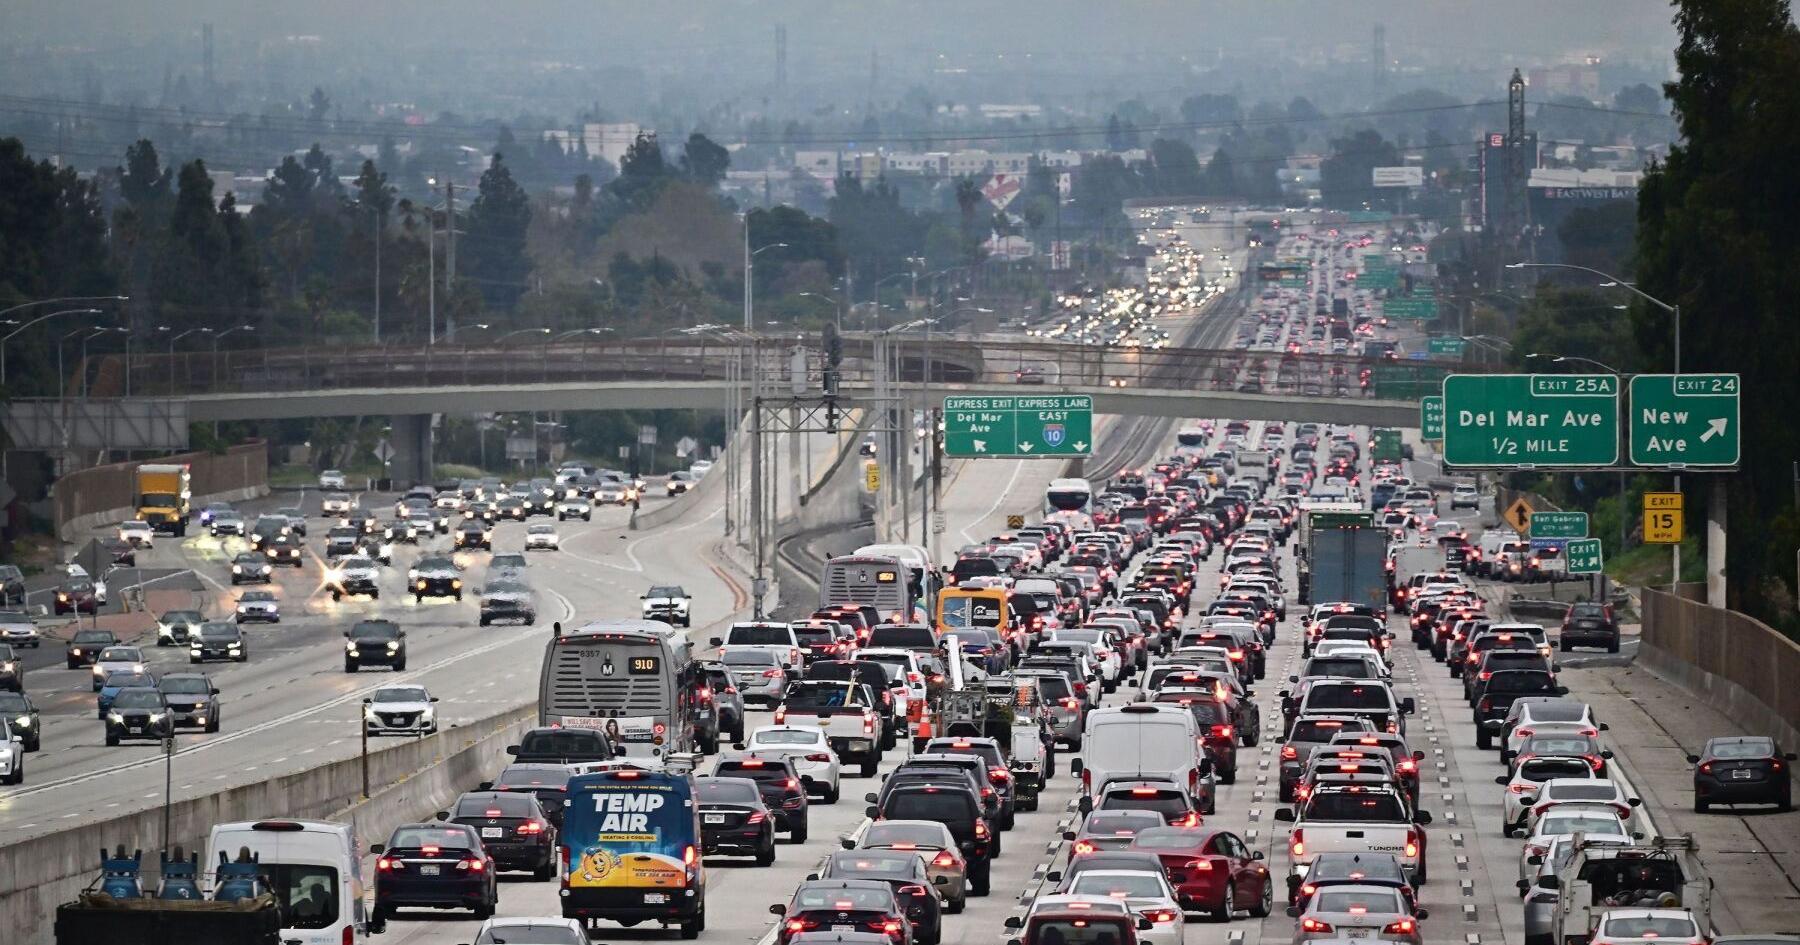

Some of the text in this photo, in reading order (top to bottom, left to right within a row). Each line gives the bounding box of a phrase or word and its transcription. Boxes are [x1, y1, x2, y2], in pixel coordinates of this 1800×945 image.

[1538, 379, 1610, 392] EXIT 25A
[1678, 379, 1736, 392] EXIT 24
[947, 399, 1013, 408] EXPRESS EXIT
[1018, 399, 1089, 408] EXPRESS LANE
[957, 413, 1003, 422] Del Mar
[1038, 411, 1069, 421] EAST
[1459, 410, 1602, 427] Del Mar Ave
[1643, 408, 1689, 425] New
[970, 424, 991, 433] Ave
[1047, 431, 1060, 442] 10
[1526, 439, 1569, 452] MILE
[1646, 435, 1687, 452] Ave
[1651, 497, 1675, 506] EXIT
[1552, 514, 1584, 523] Gabriel
[1652, 513, 1674, 529] 15
[1570, 543, 1596, 554] EXIT
[1570, 558, 1584, 568] 24
[602, 664, 613, 675] M
[634, 659, 654, 670] 910
[592, 793, 664, 812] TEMP
[600, 813, 649, 832] AIR
